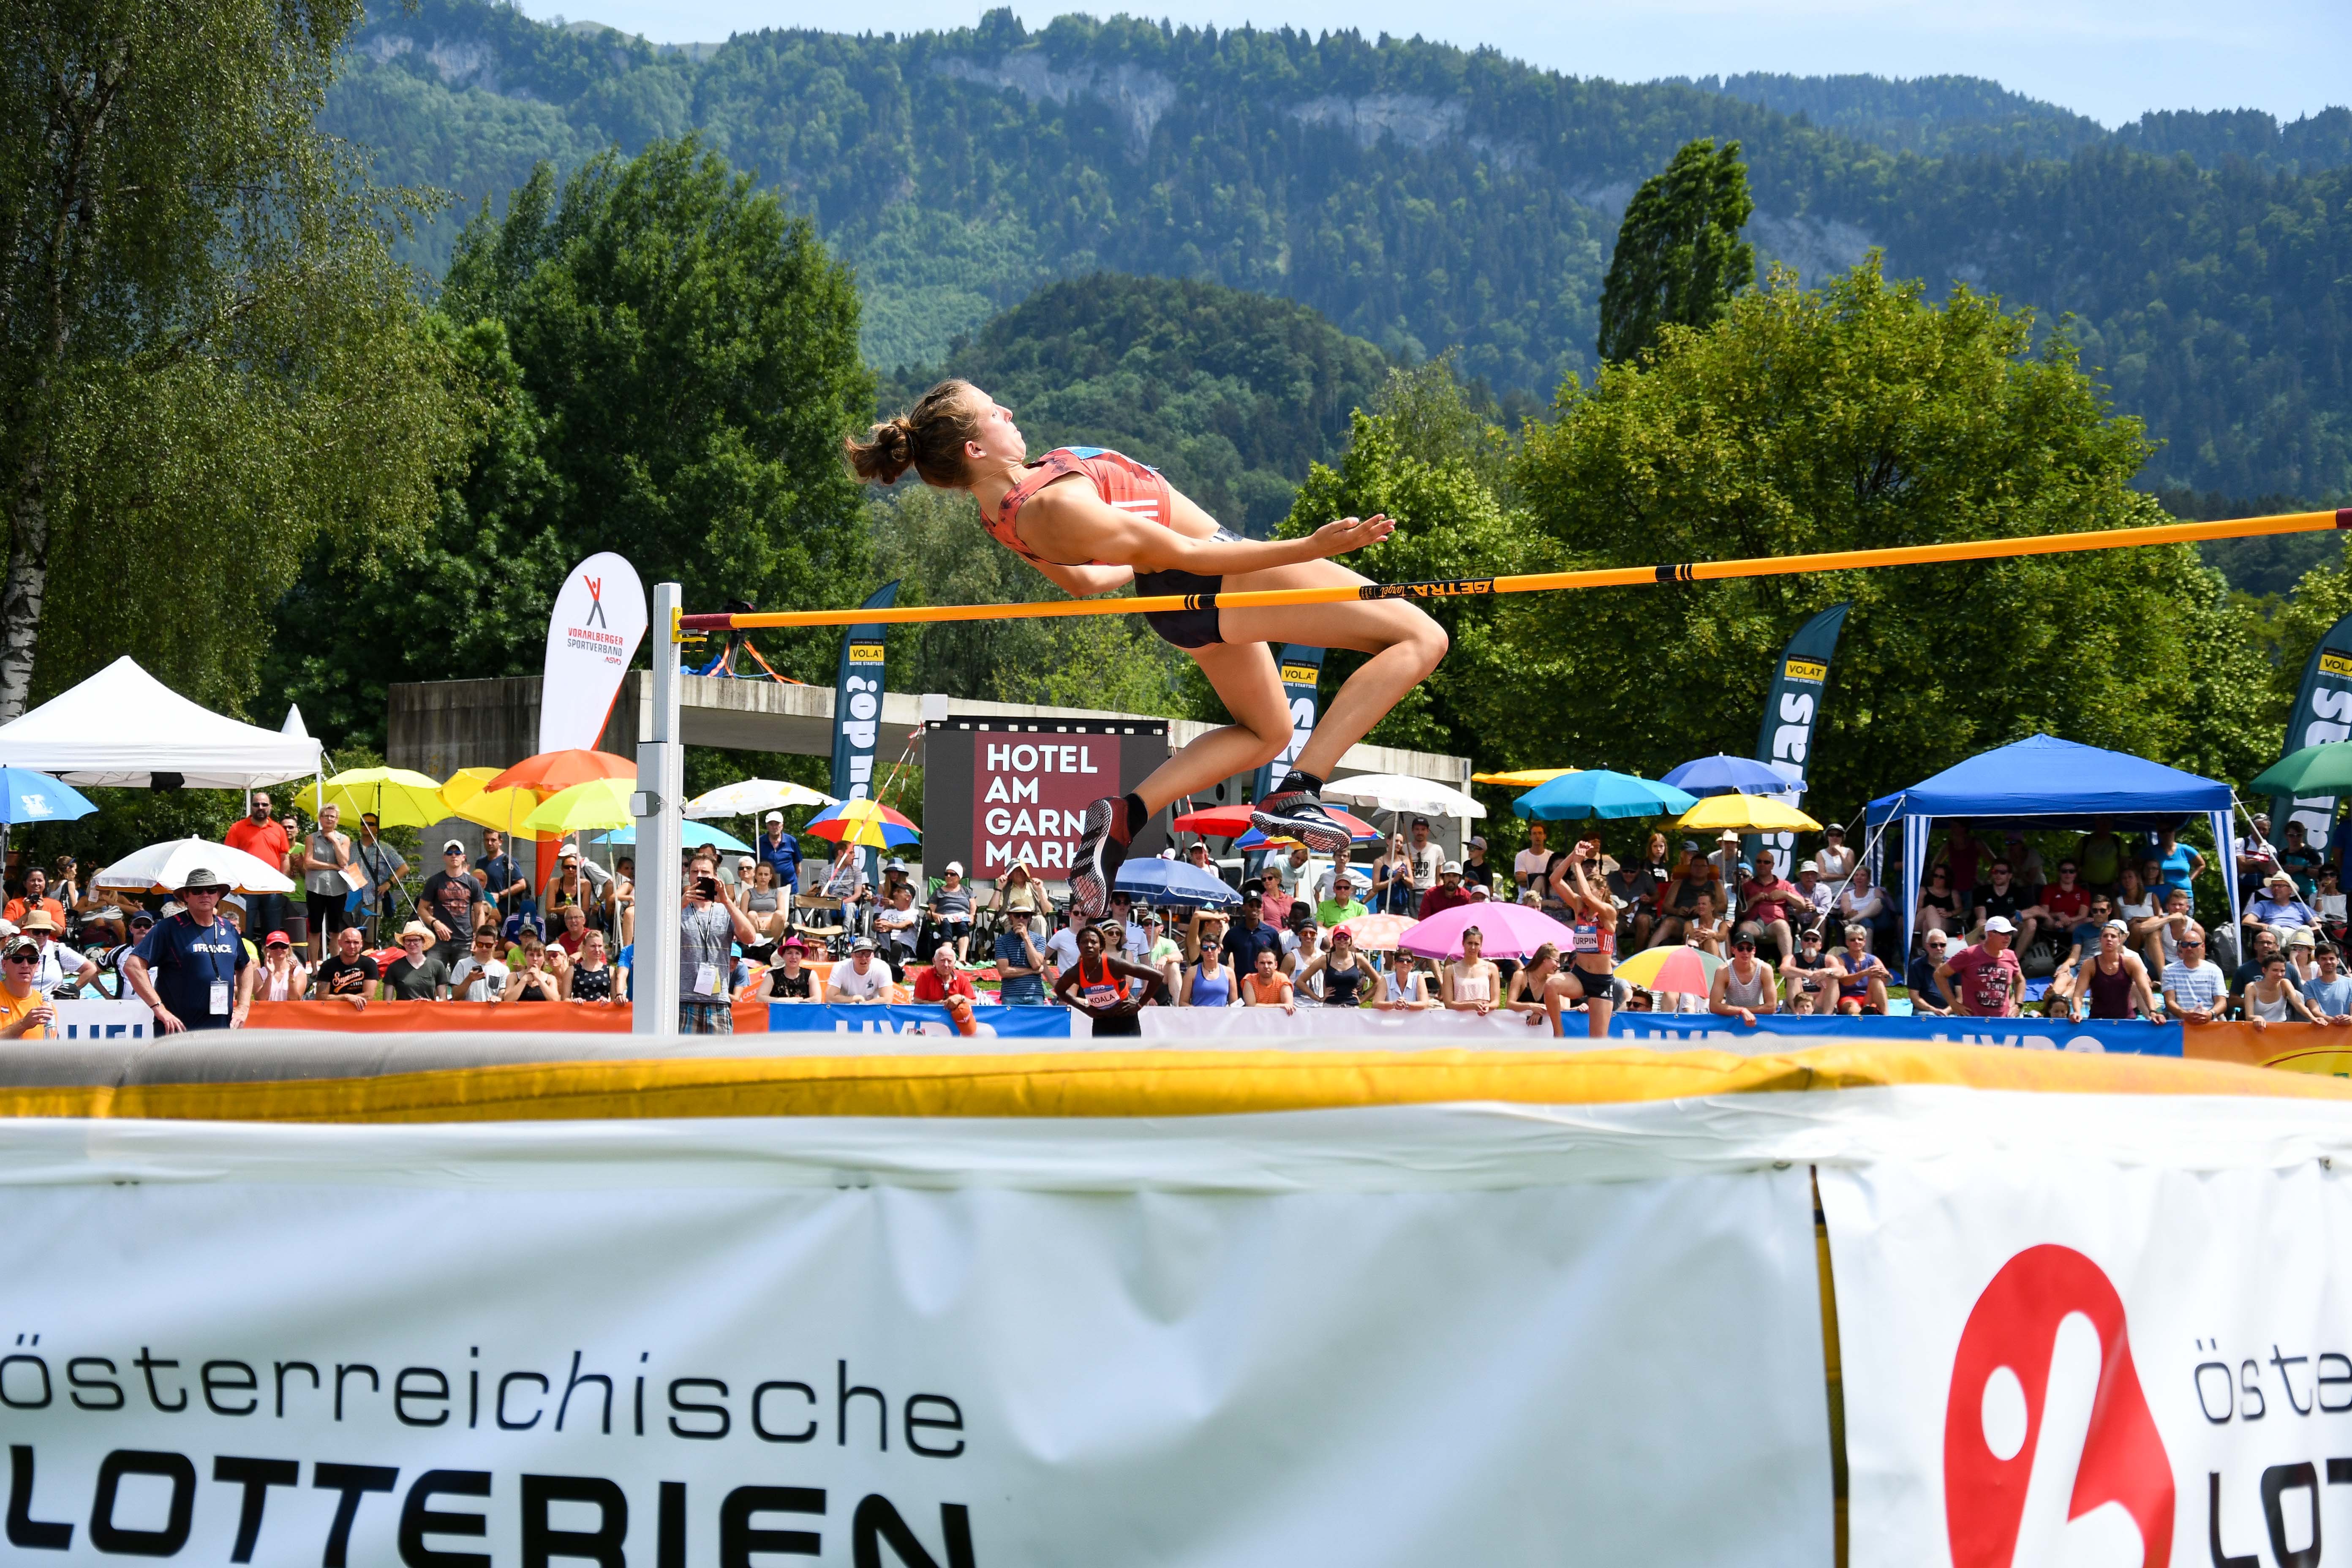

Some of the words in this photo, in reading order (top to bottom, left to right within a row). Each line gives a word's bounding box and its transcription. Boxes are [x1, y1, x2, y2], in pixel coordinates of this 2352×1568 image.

[1378, 584, 1407, 599] target
[568, 627, 623, 646] VORARLBERGER
[567, 638, 622, 656] SPORTVERBAND
[853, 649, 882, 658] VOL.AT
[1285, 670, 1315, 680] VOL.AT
[842, 675, 878, 749] do?
[987, 743, 1098, 773] HOTEL
[984, 776, 1038, 803] AM
[197, 943, 232, 953] FRANCE
[1089, 994, 1115, 1004] KOALA
[2194, 1338, 2352, 1424] öste
[0, 1333, 966, 1459] österreichische
[5, 1444, 977, 1568] LOTTERIEN
